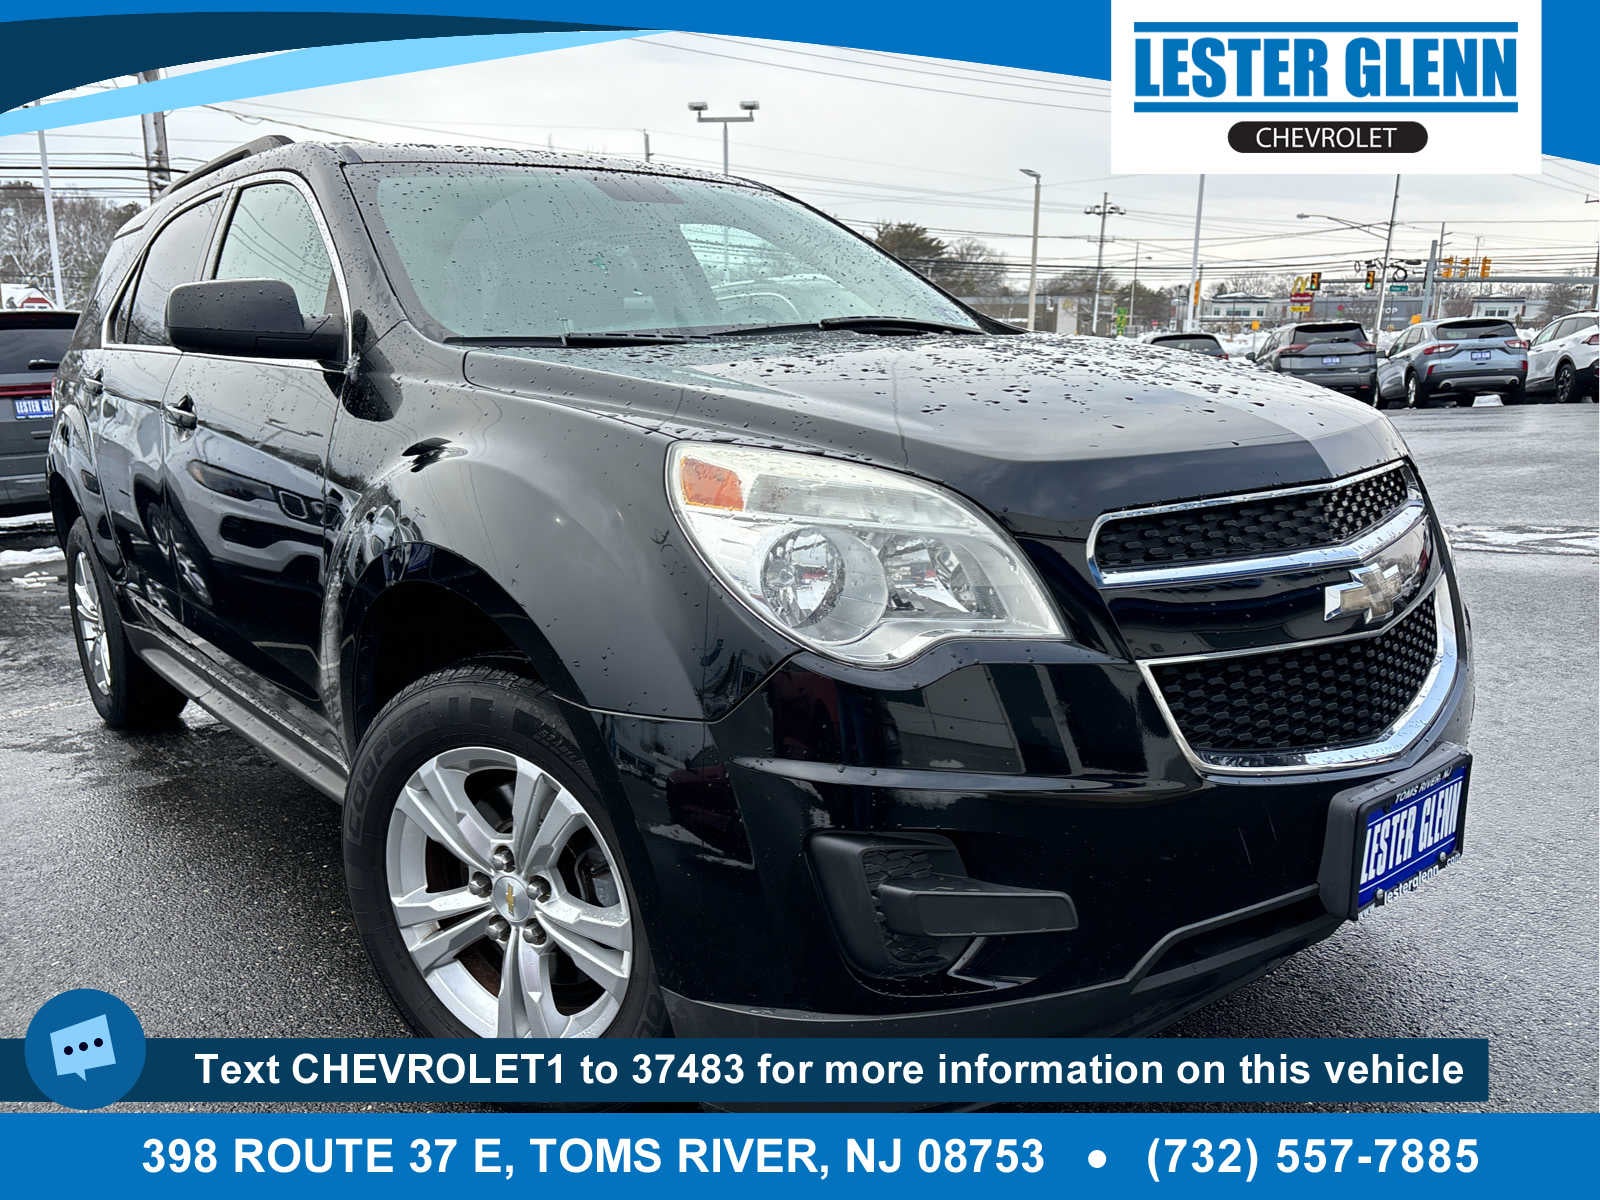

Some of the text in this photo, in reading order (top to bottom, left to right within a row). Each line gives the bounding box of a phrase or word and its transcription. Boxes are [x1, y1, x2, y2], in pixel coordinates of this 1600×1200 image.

[15, 400, 41, 414] LESTER
[1395, 783, 1418, 804] TOMS
[1360, 780, 1463, 885] LESTER GLENN
